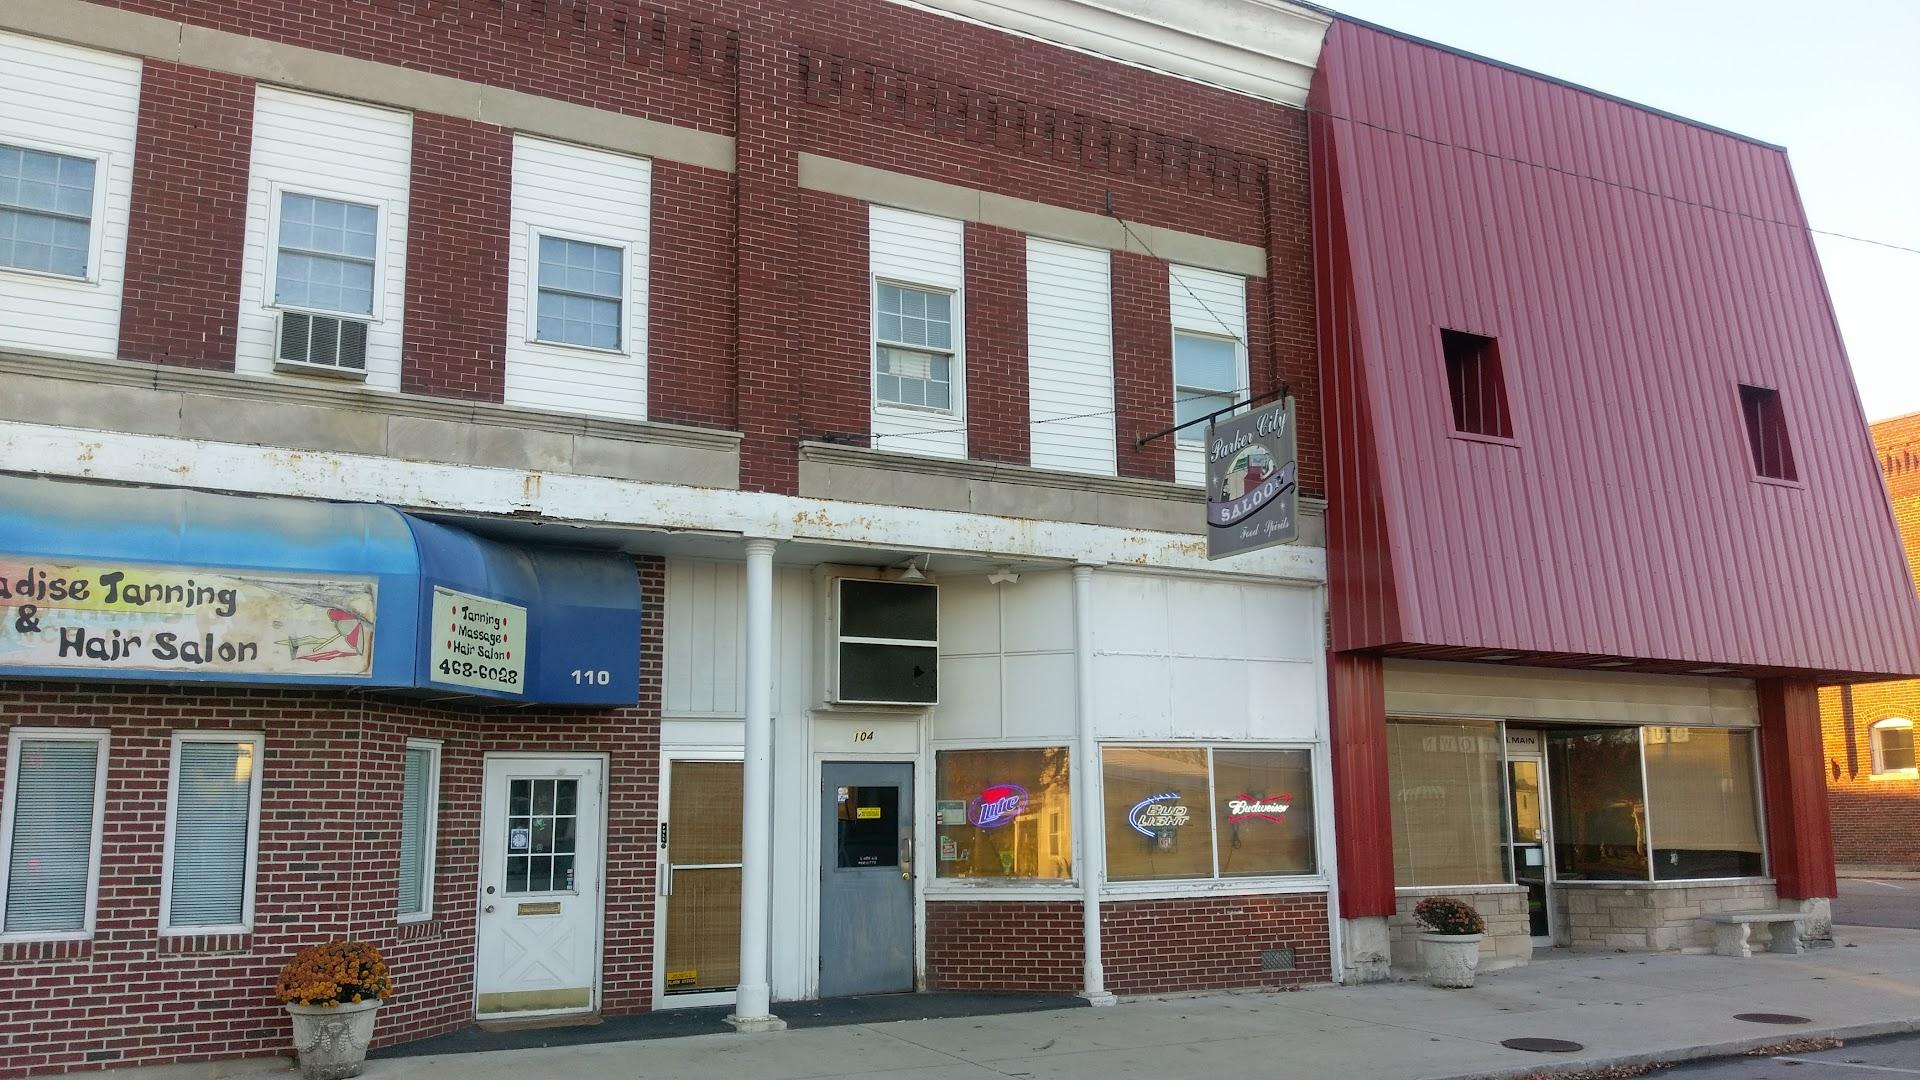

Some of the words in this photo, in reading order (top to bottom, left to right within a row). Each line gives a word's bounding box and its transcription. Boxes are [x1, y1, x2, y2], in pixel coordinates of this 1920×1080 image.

[1211, 428, 1252, 463] Parker
[1256, 408, 1287, 438] City
[1240, 524, 1259, 540] Food
[99, 571, 237, 617] Tanning
[15, 604, 41, 633] &
[463, 606, 500, 629] Tanning
[458, 625, 502, 645] Massage
[58, 627, 142, 661] Hair
[151, 632, 257, 664] Salon
[453, 640, 475, 655] Hair
[478, 645, 504, 660] Salon
[439, 659, 517, 684] 468-6028
[571, 670, 610, 685] 110
[853, 731, 874, 743] 104
[1512, 736, 1535, 744] MAIN
[1147, 804, 1187, 816] BUD
[1228, 800, 1290, 815] Budweiser
[1138, 814, 1190, 826] LIGHT
